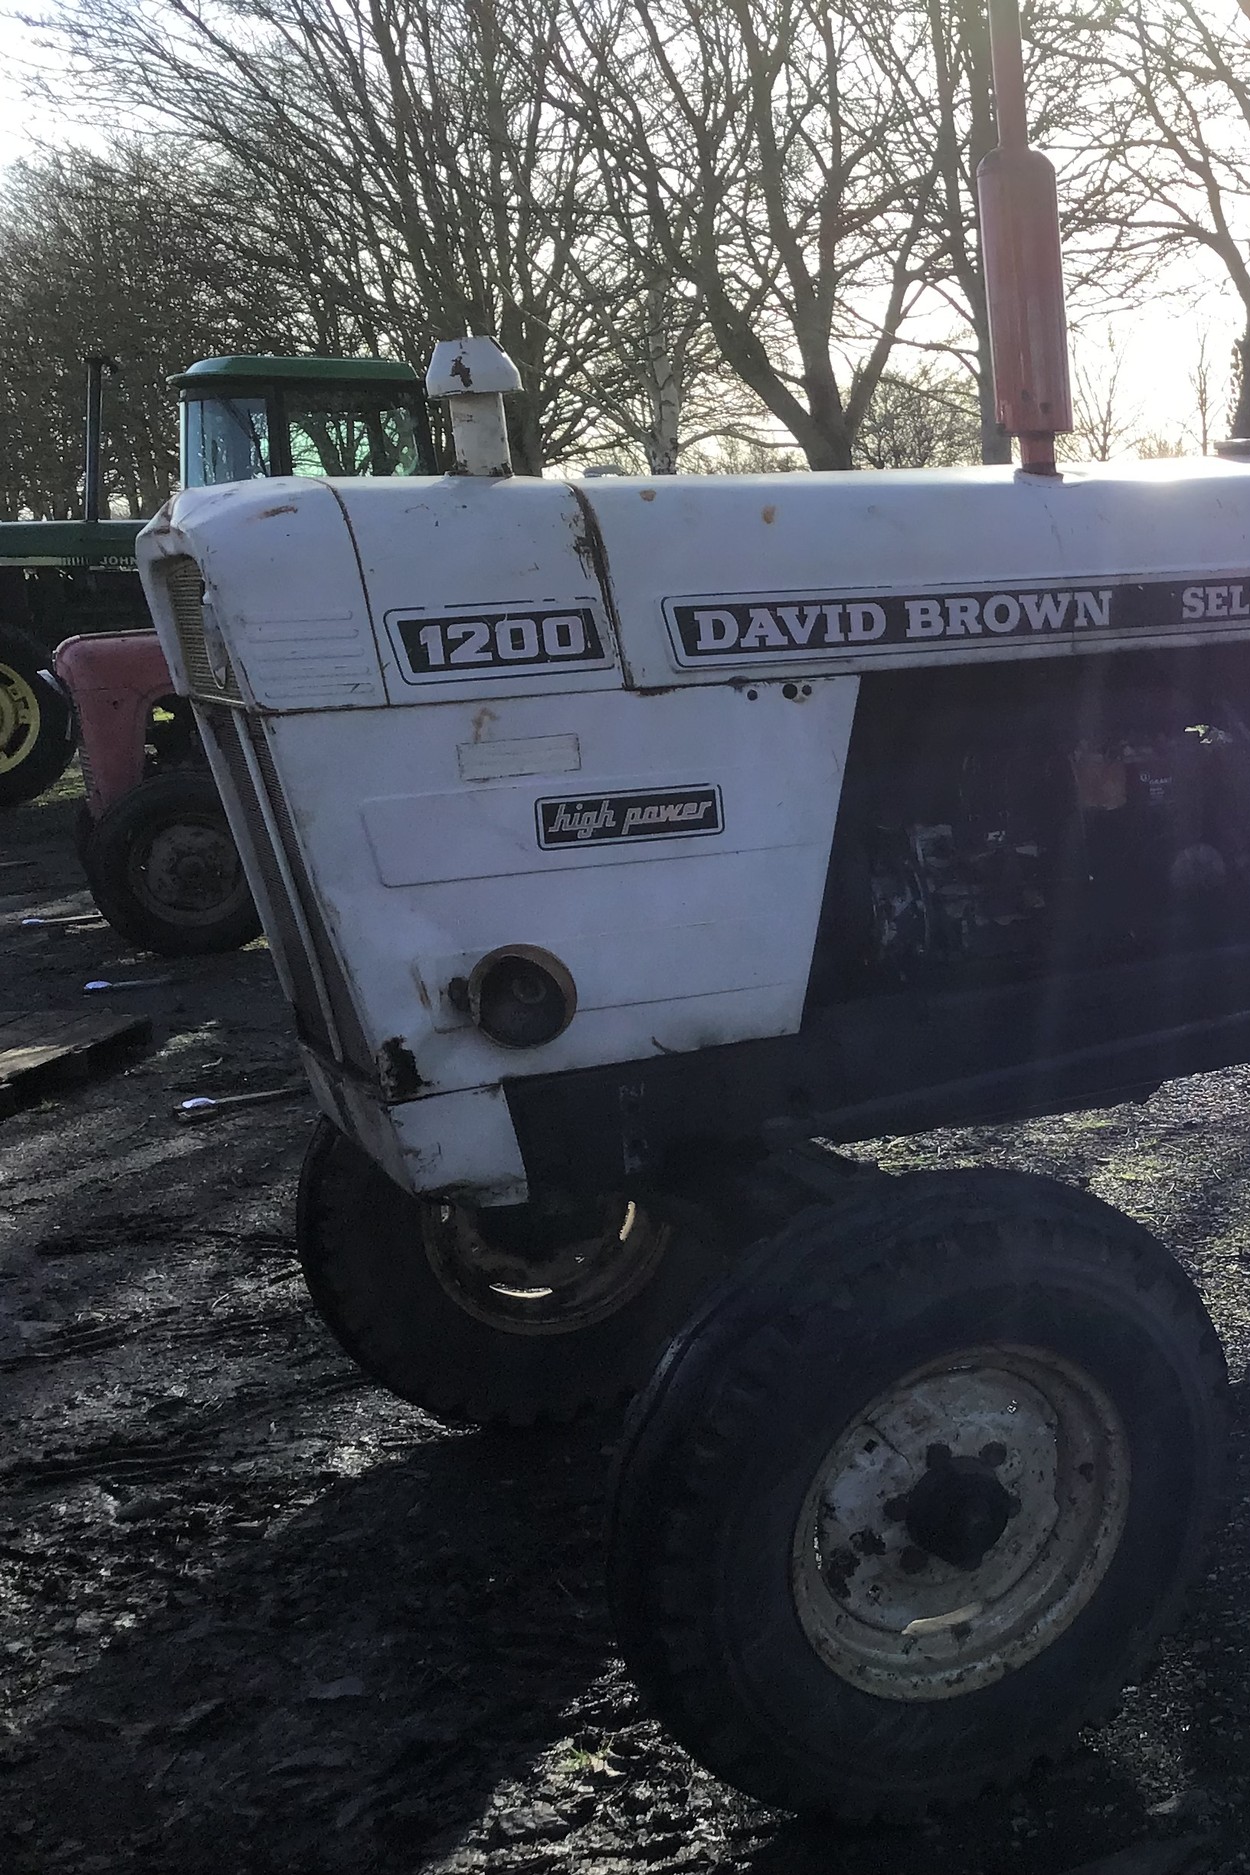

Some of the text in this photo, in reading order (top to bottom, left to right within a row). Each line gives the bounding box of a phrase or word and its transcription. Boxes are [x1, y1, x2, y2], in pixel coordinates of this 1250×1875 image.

[100, 556, 137, 566] JOHN
[418, 615, 587, 666] 1200
[696, 590, 1113, 651] DAVID BROWN
[548, 800, 712, 840] high power
